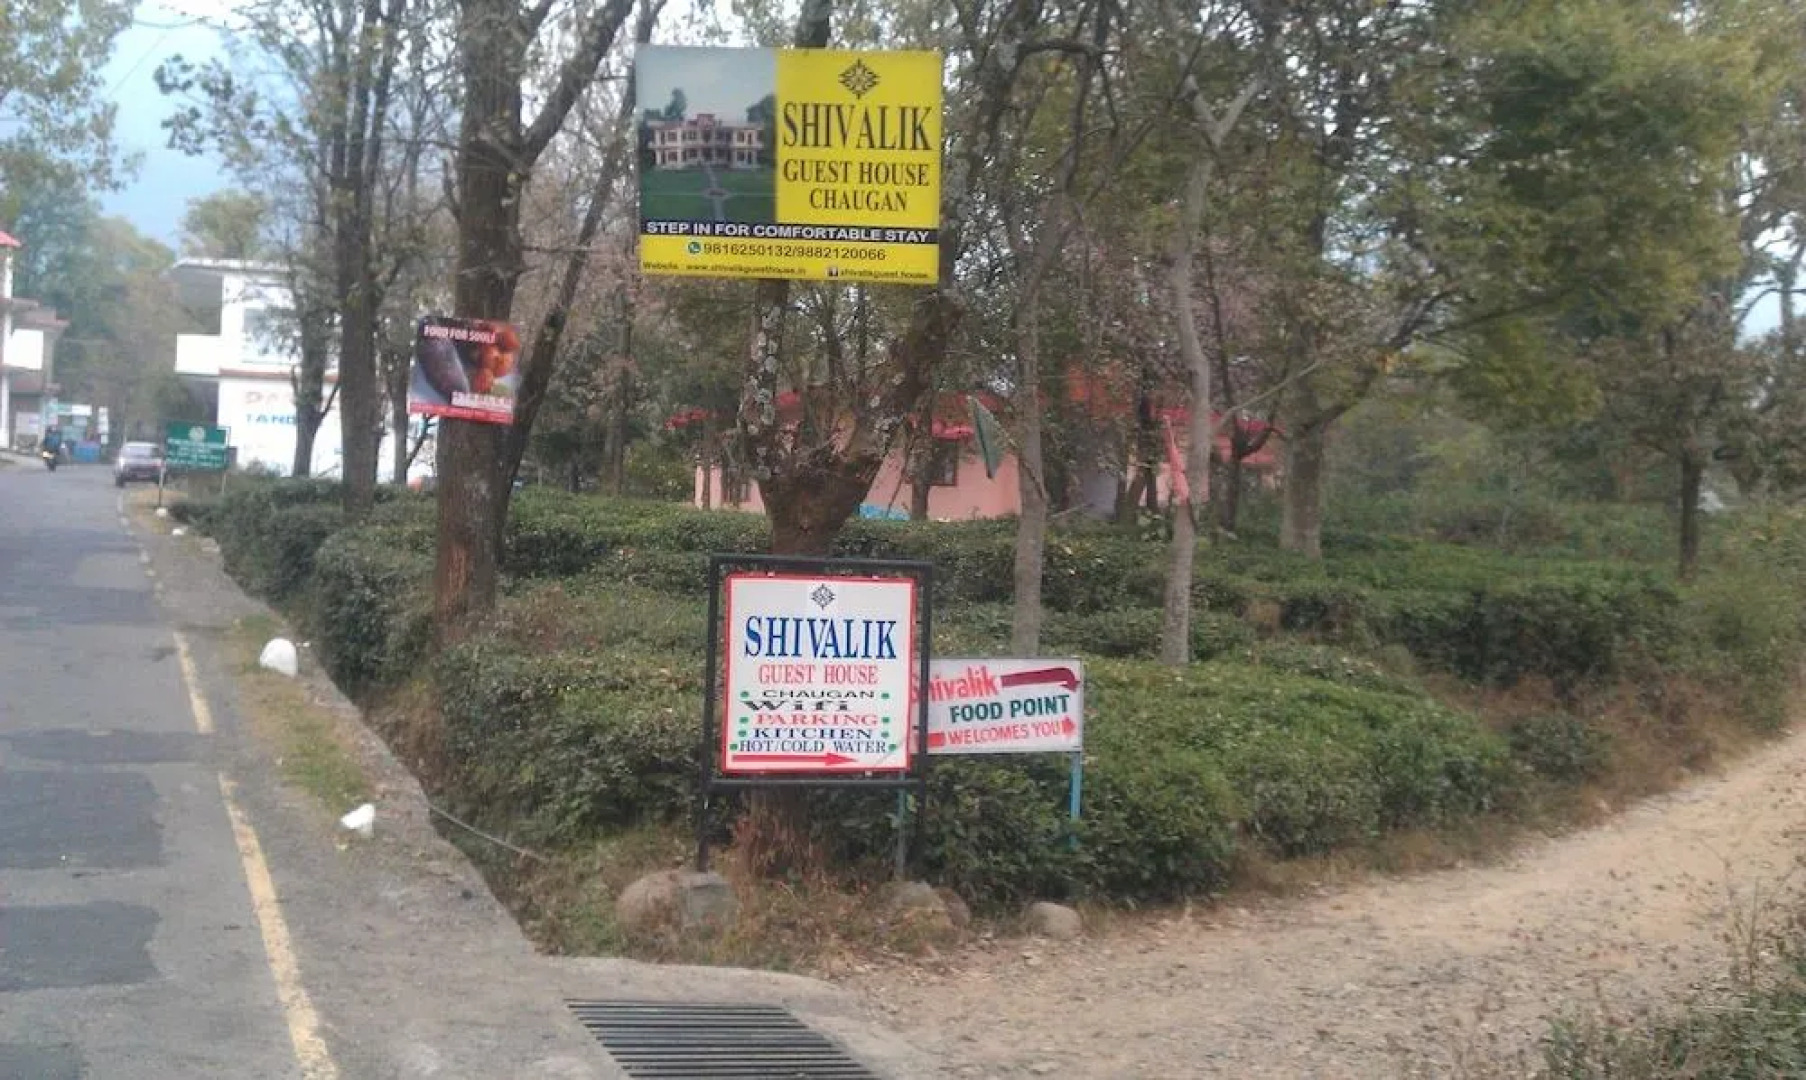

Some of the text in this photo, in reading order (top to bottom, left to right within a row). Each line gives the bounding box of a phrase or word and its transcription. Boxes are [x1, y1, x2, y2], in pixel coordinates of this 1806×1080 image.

[782, 101, 933, 151] SHIVALIK
[783, 159, 930, 187] GUEST HOUSE
[809, 188, 908, 212] CHAUGAN
[646, 221, 930, 243] STEP IN FOR COMFORTABLE STAY
[703, 243, 887, 261] 9816250132/9882120066
[744, 614, 898, 660] SHIVALIK
[758, 664, 880, 685] GUEST HOUSE
[762, 689, 875, 699] CHAUGAN
[755, 714, 879, 726] PARKING
[949, 694, 1070, 724] FOOD POINT
[754, 728, 873, 740] KITCHEN
[947, 721, 1061, 745] WELCOMES YOU
[739, 740, 888, 754] HOT/COLD WATER
